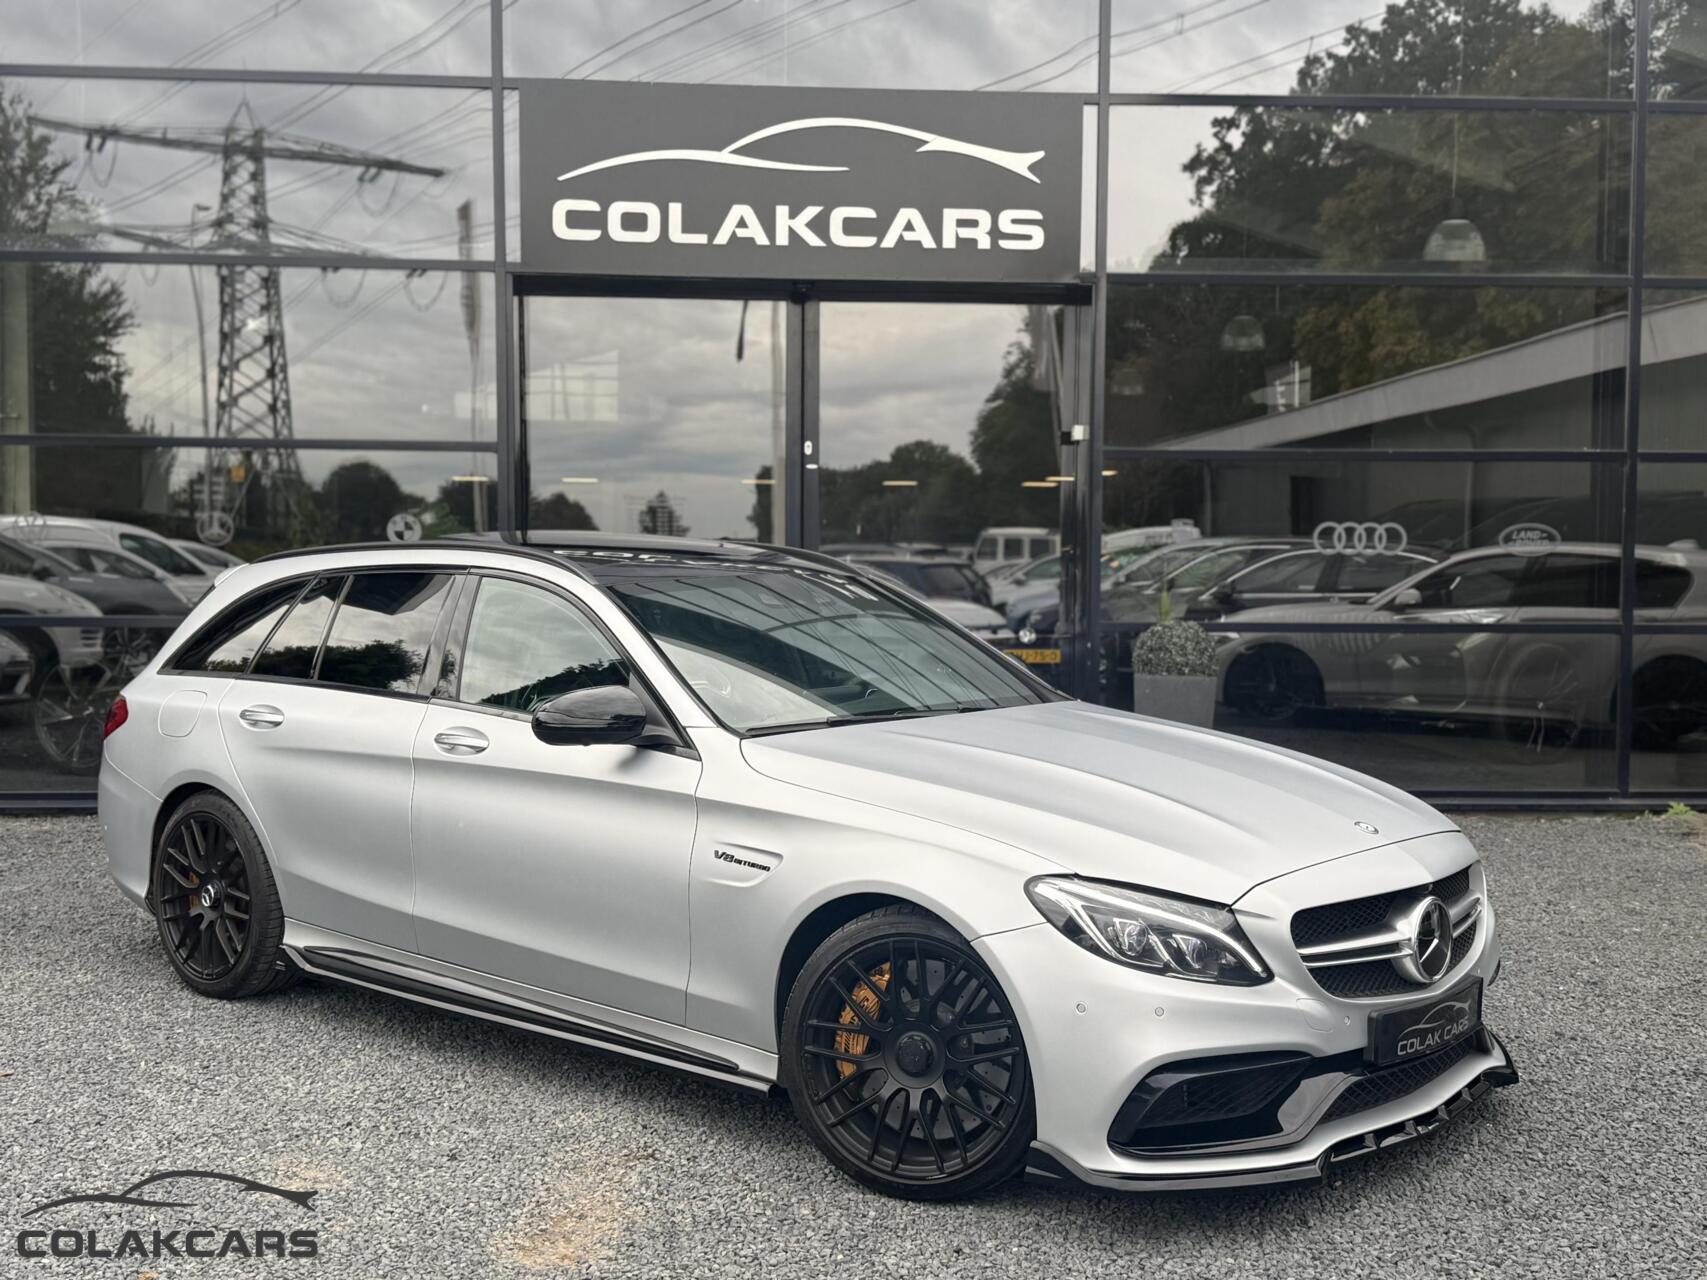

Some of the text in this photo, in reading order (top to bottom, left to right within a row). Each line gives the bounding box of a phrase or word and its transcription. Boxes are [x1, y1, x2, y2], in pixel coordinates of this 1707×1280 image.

[552, 198, 1045, 251] COLAKCARS
[714, 849, 735, 863] V8
[1397, 1016, 1470, 1056] COLAK CARS
